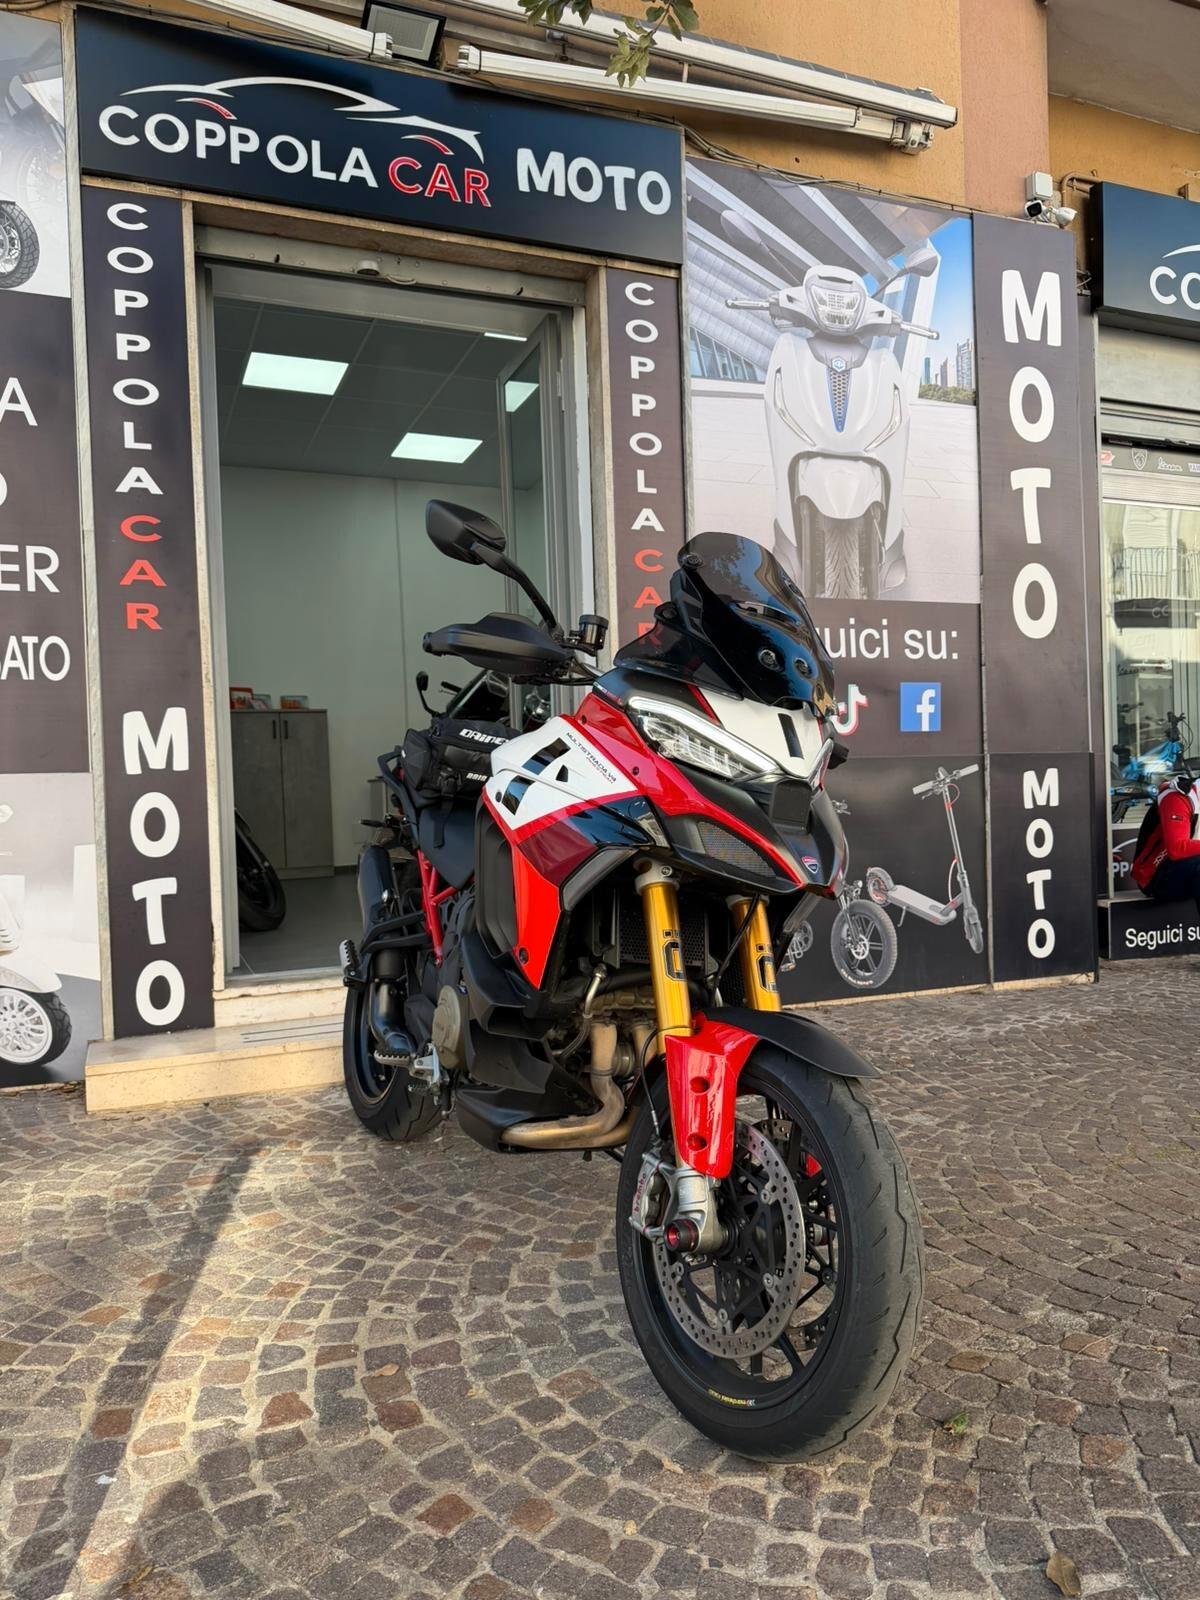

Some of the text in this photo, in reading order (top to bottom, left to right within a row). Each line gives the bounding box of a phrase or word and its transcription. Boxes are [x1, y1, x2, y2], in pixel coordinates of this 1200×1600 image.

[99, 104, 672, 215] COPPOLA CAR MOTO
[624, 282, 665, 532] COPPOLA
[1001, 269, 1062, 639] MOTO
[0, 635, 70, 682] ATO
[106, 202, 190, 1026] COPPOLA CAR MOTO
[816, 617, 959, 660] uici su:
[459, 728, 508, 745] DAINE
[1022, 767, 1060, 959] MOTO
[1125, 923, 1183, 950] Seguici
